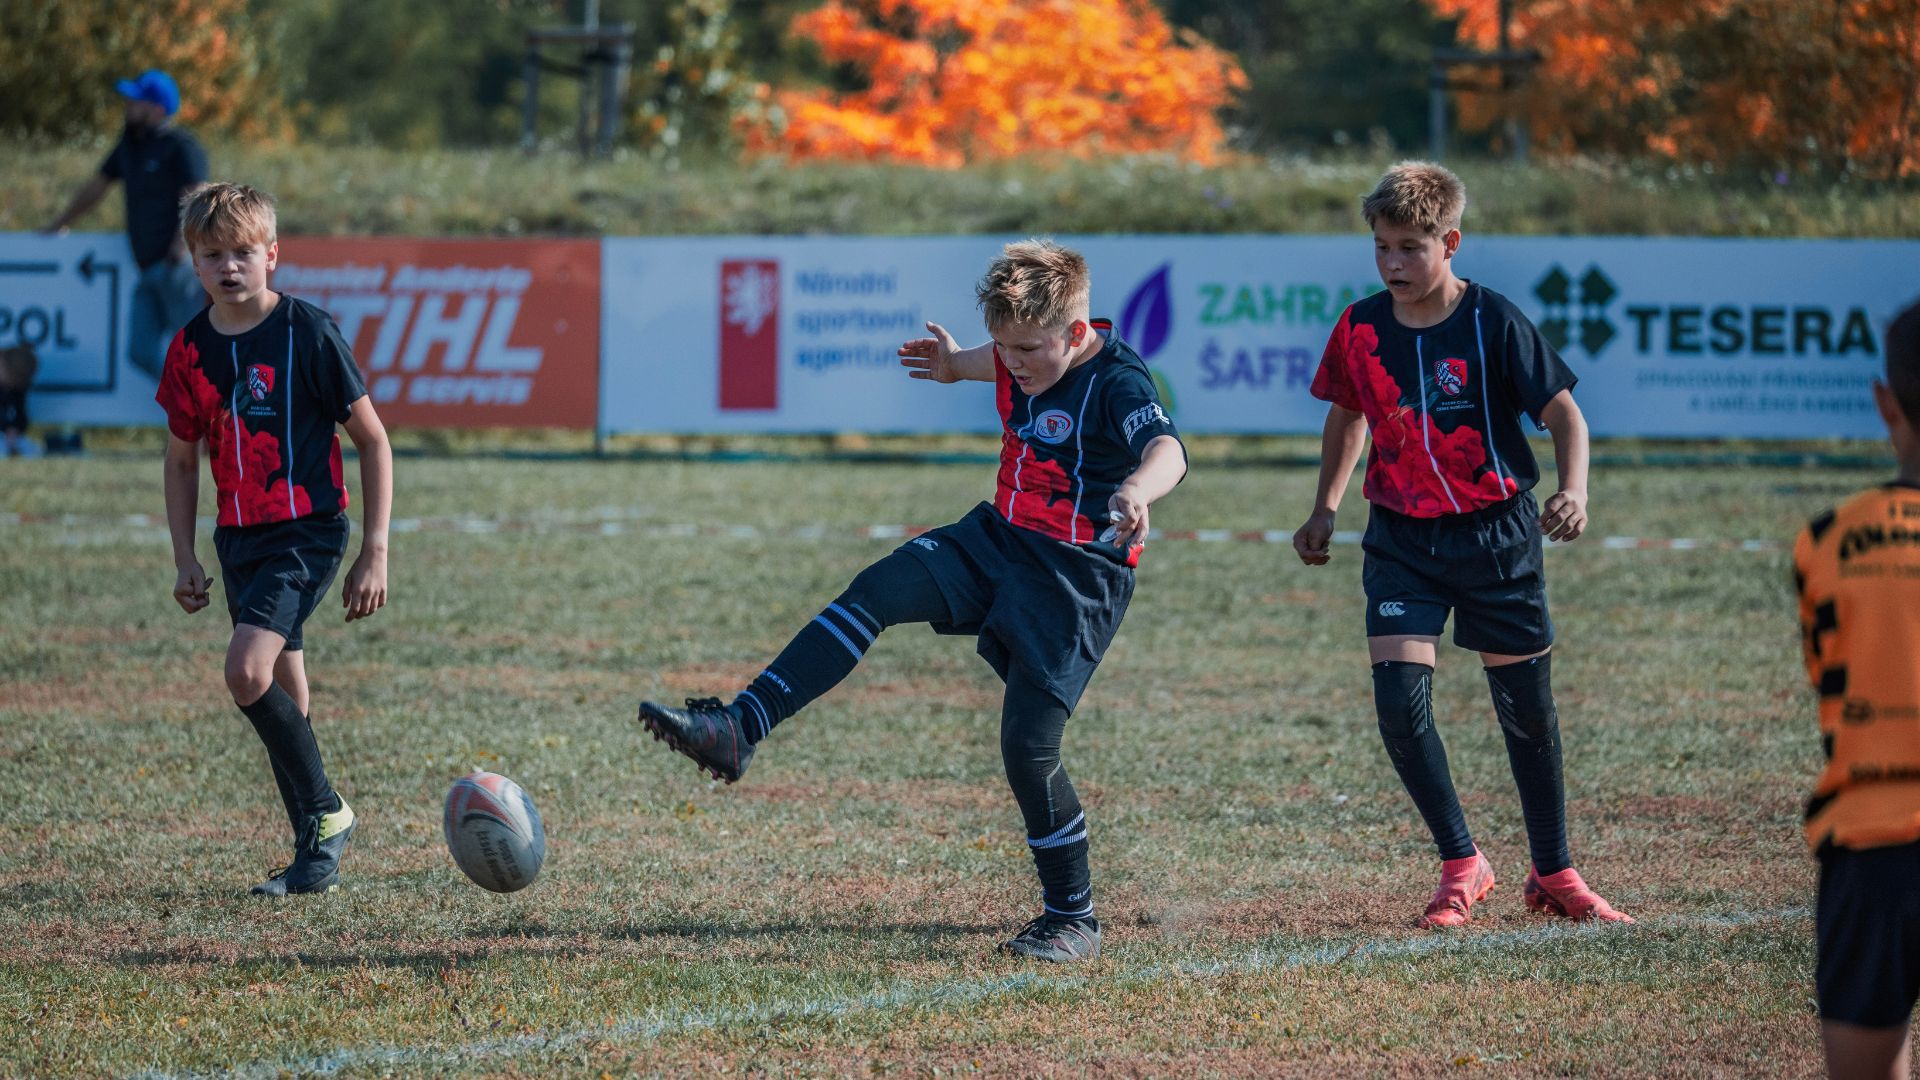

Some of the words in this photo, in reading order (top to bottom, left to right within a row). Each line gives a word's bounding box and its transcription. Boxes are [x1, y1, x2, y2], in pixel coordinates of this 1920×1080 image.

[286, 293, 543, 371] TIHL
[1626, 306, 1877, 355] TESERA
[1199, 338, 1315, 388] ŠAFR
